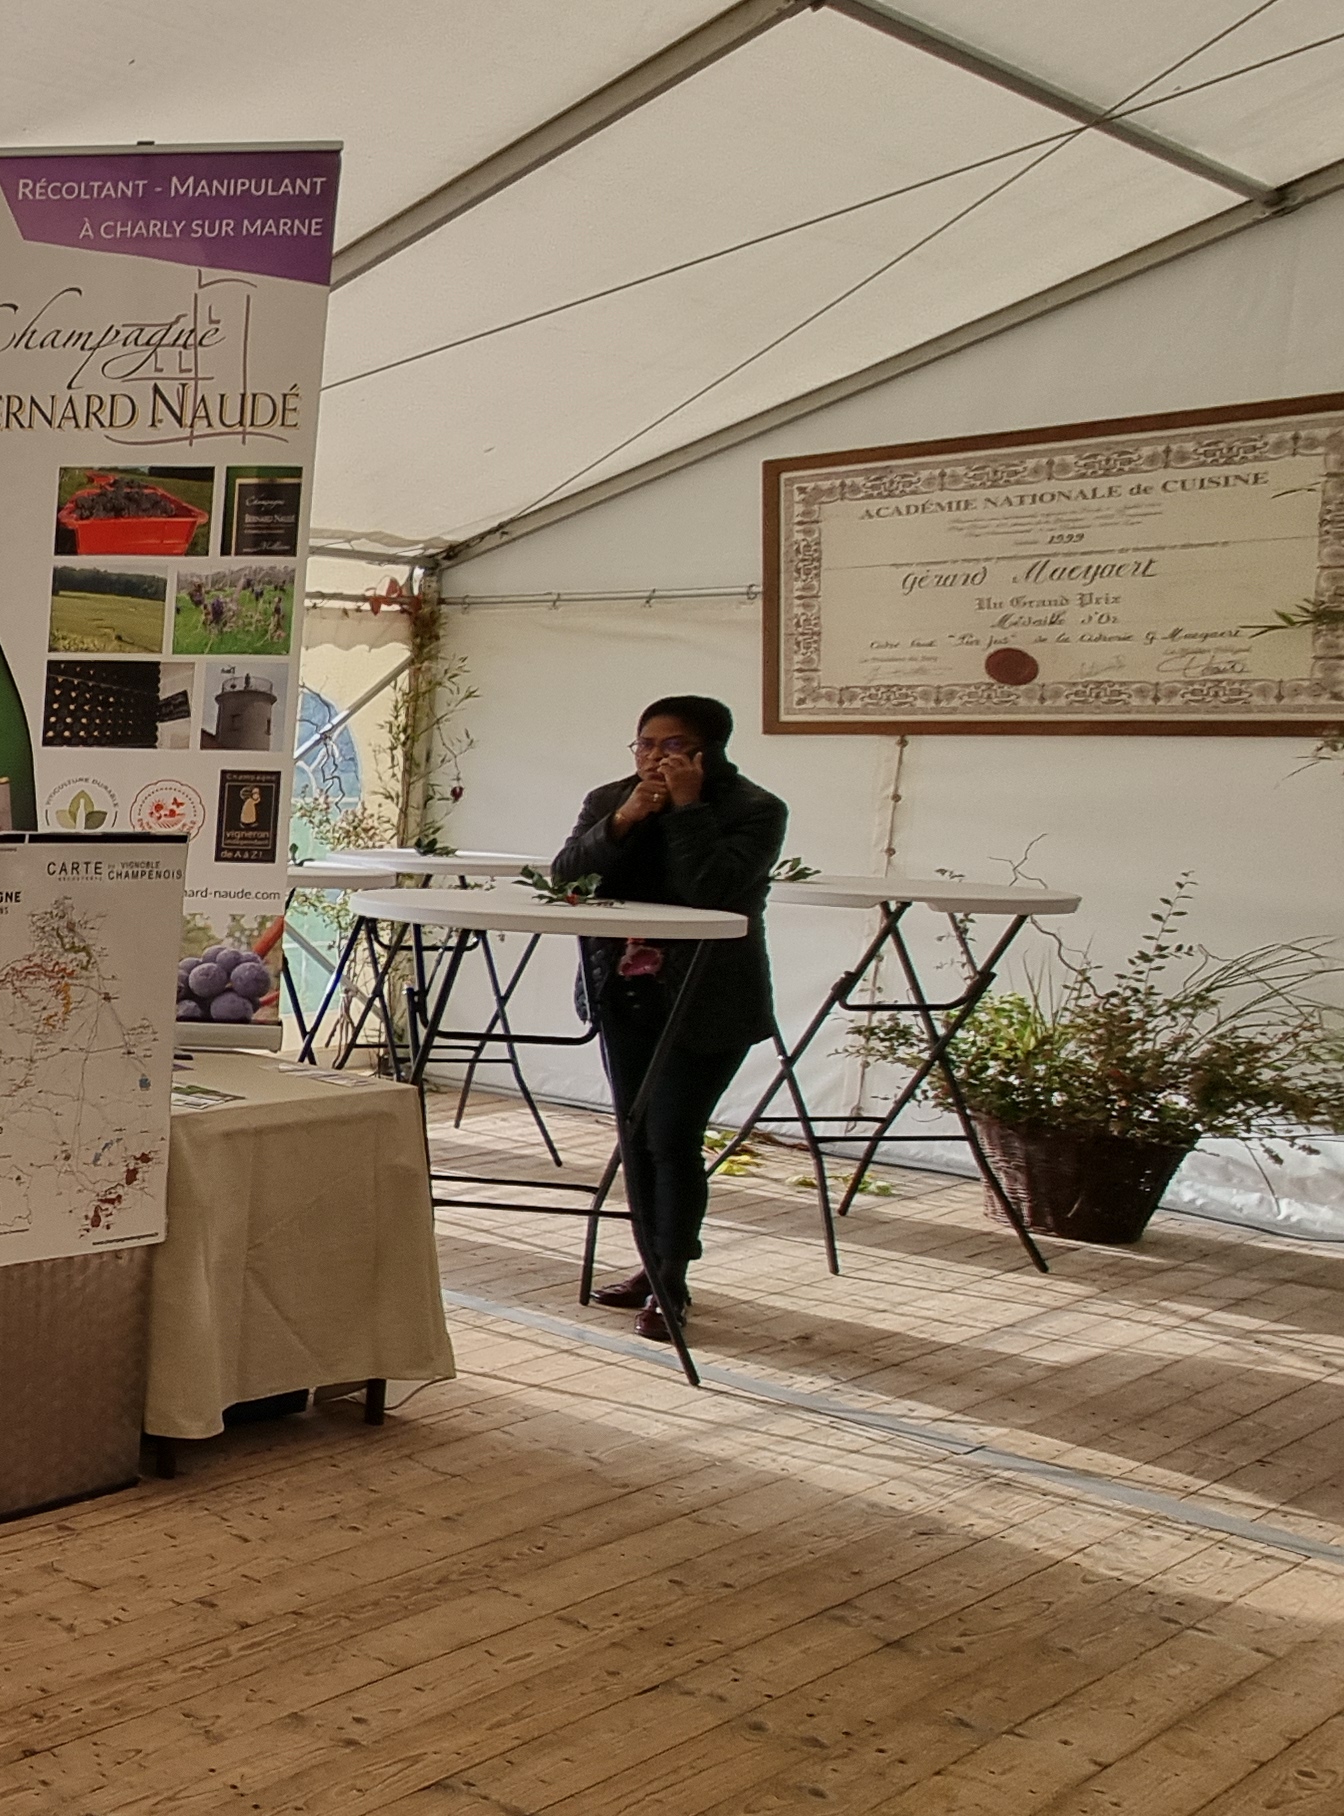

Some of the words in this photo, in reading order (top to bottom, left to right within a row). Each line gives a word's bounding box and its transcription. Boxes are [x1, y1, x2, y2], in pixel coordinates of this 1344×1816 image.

[18, 177, 147, 200] RÉCOLTANT
[171, 175, 327, 198] MANIPULANT
[79, 217, 94, 240] À
[99, 220, 187, 239] CHARLY
[191, 218, 235, 238] SUR
[242, 218, 324, 237] MARNE
[149, 383, 302, 430] NAUDÉ
[858, 499, 976, 521] ACADÉMIE
[983, 484, 1122, 508] NATIONALE
[1128, 482, 1154, 497] de
[1161, 471, 1270, 494] CUISINE
[901, 565, 989, 595] Gérard
[1009, 594, 1070, 609] Grand
[1076, 591, 1122, 608] Prix
[225, 830, 270, 839] vigneron
[46, 861, 103, 876] CARTE
[107, 869, 183, 881] CHAMPENOIS
[120, 861, 160, 869] VIGNOBLE
